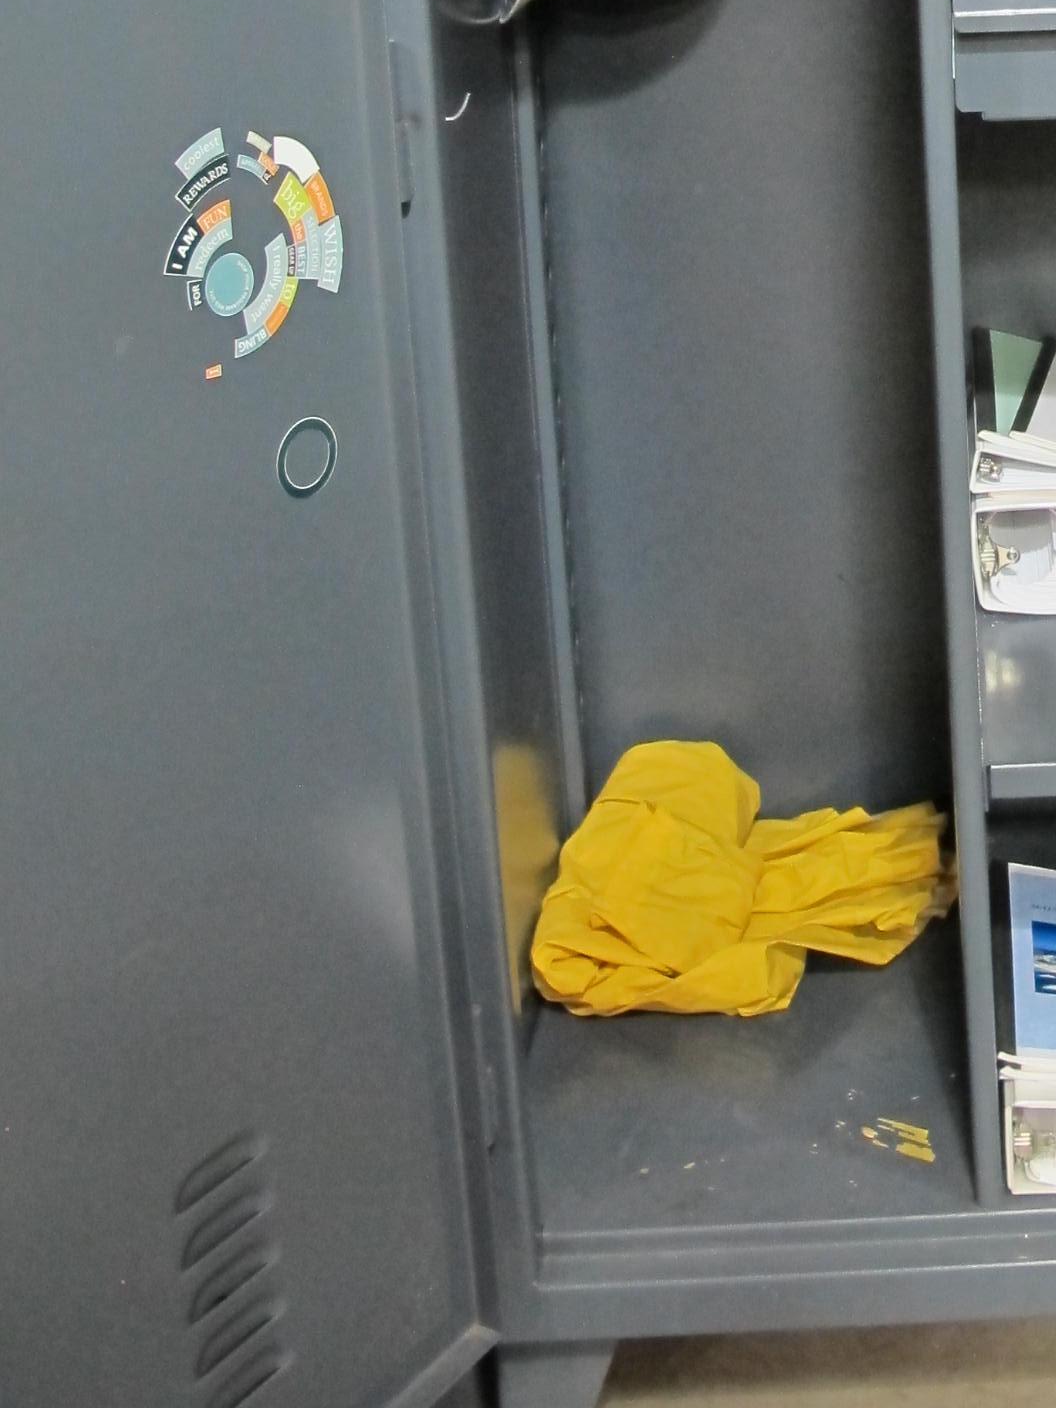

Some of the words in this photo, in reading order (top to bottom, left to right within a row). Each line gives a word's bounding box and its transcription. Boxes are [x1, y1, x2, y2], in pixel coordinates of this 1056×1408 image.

[183, 136, 221, 171] coolest
[182, 162, 229, 205] REWARDS
[281, 183, 304, 218] big
[203, 205, 229, 230] FUN
[177, 226, 198, 259] AM
[323, 222, 338, 285] WISH
[171, 262, 184, 271] I
[269, 253, 283, 289] really
[297, 245, 306, 274] BEST
[192, 284, 202, 307] FOR
[238, 325, 267, 353] BLING
